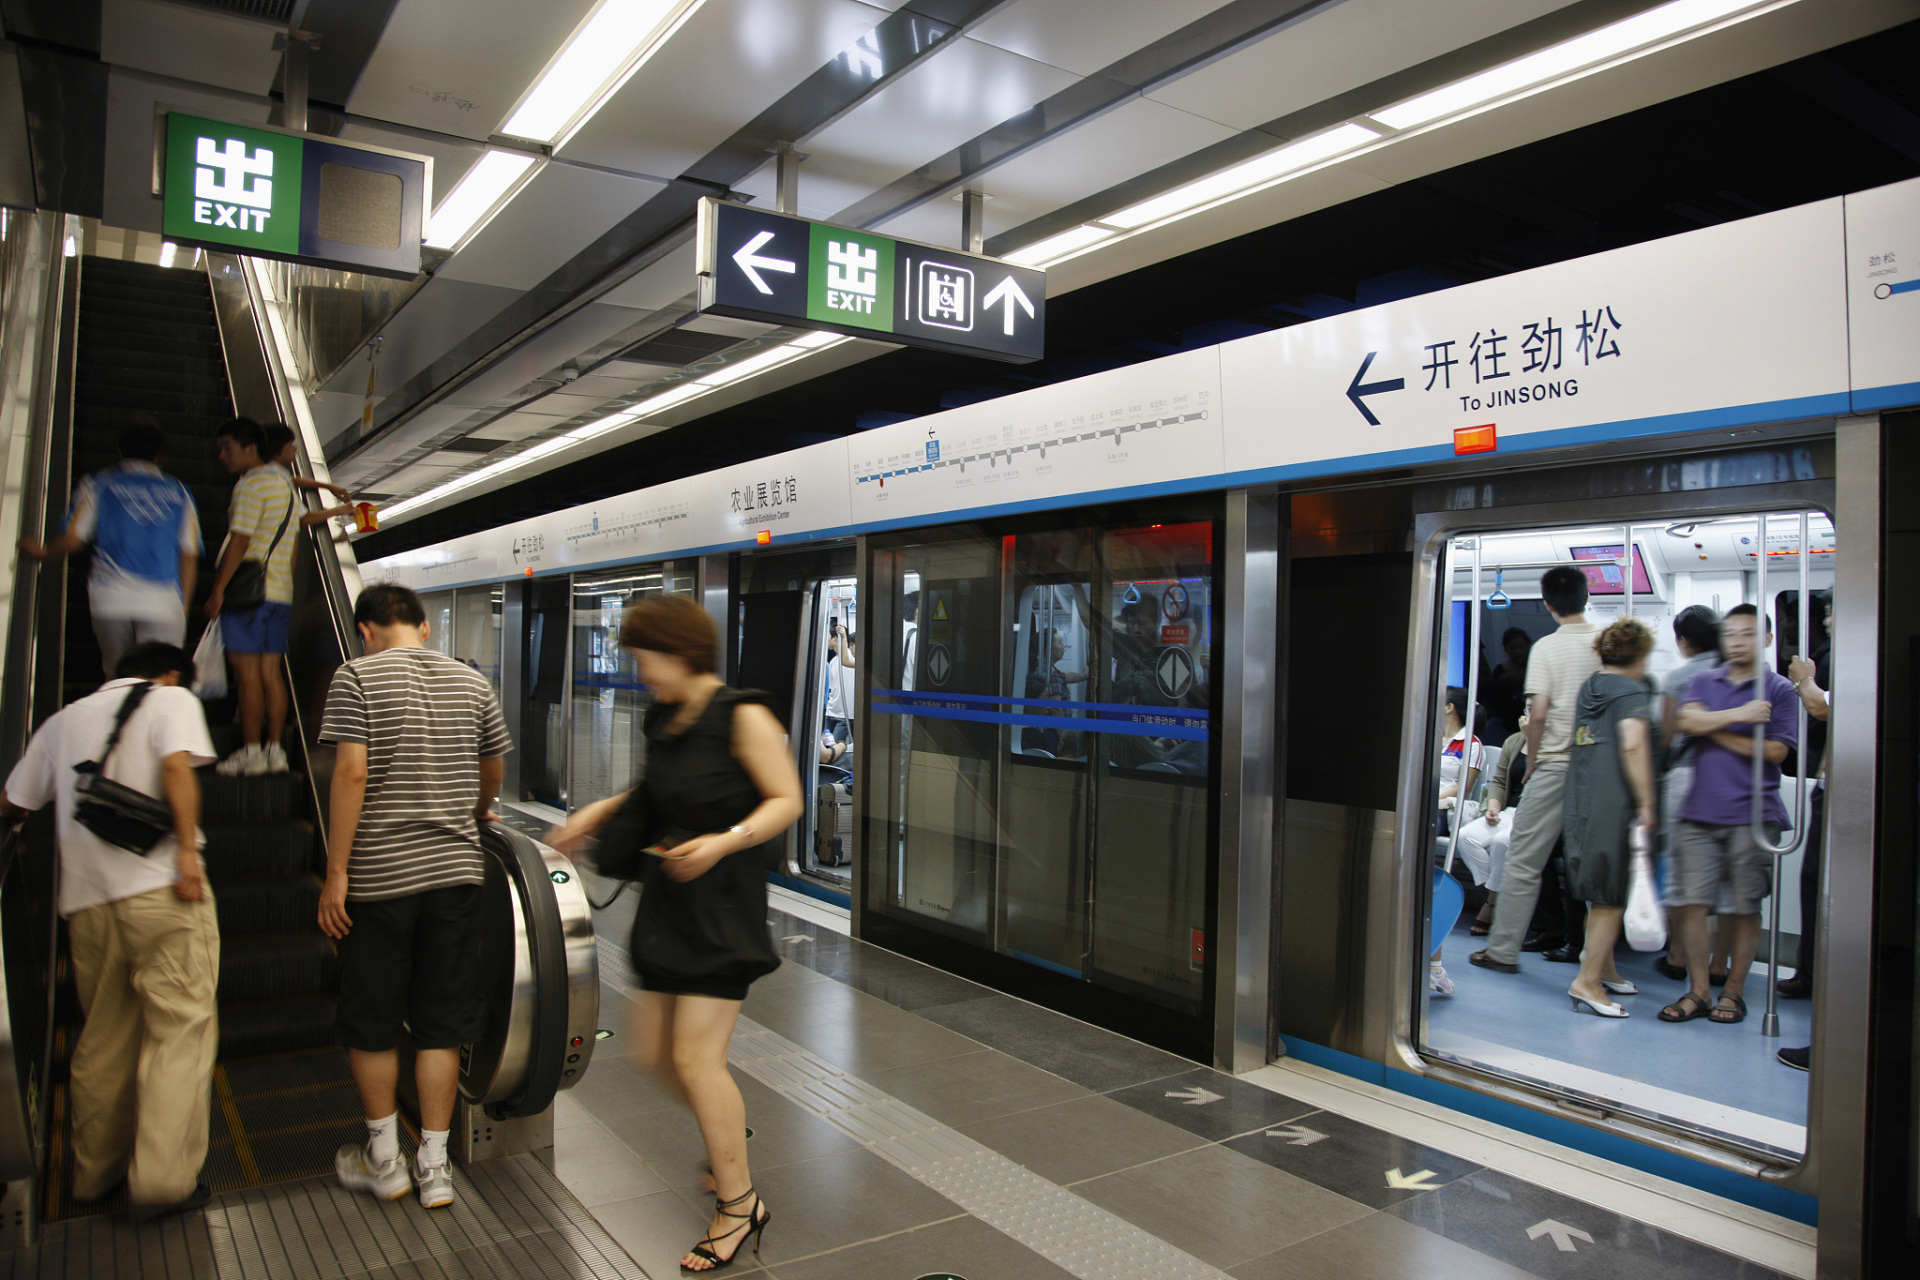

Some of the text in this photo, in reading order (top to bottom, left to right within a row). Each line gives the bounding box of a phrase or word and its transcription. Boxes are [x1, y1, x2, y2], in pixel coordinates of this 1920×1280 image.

[195, 136, 274, 210] 出
[194, 200, 271, 233] EXIT
[827, 240, 878, 296] 出
[1866, 267, 1899, 279] JINSONG
[1868, 252, 1896, 267] 劲松
[826, 290, 876, 315] EXIT
[1422, 305, 1623, 392] 开往劲松
[1459, 379, 1579, 412] To JINSONG
[730, 474, 798, 514] 农业展览馆
[758, 513, 777, 523] Exhibition
[777, 511, 791, 520] Center
